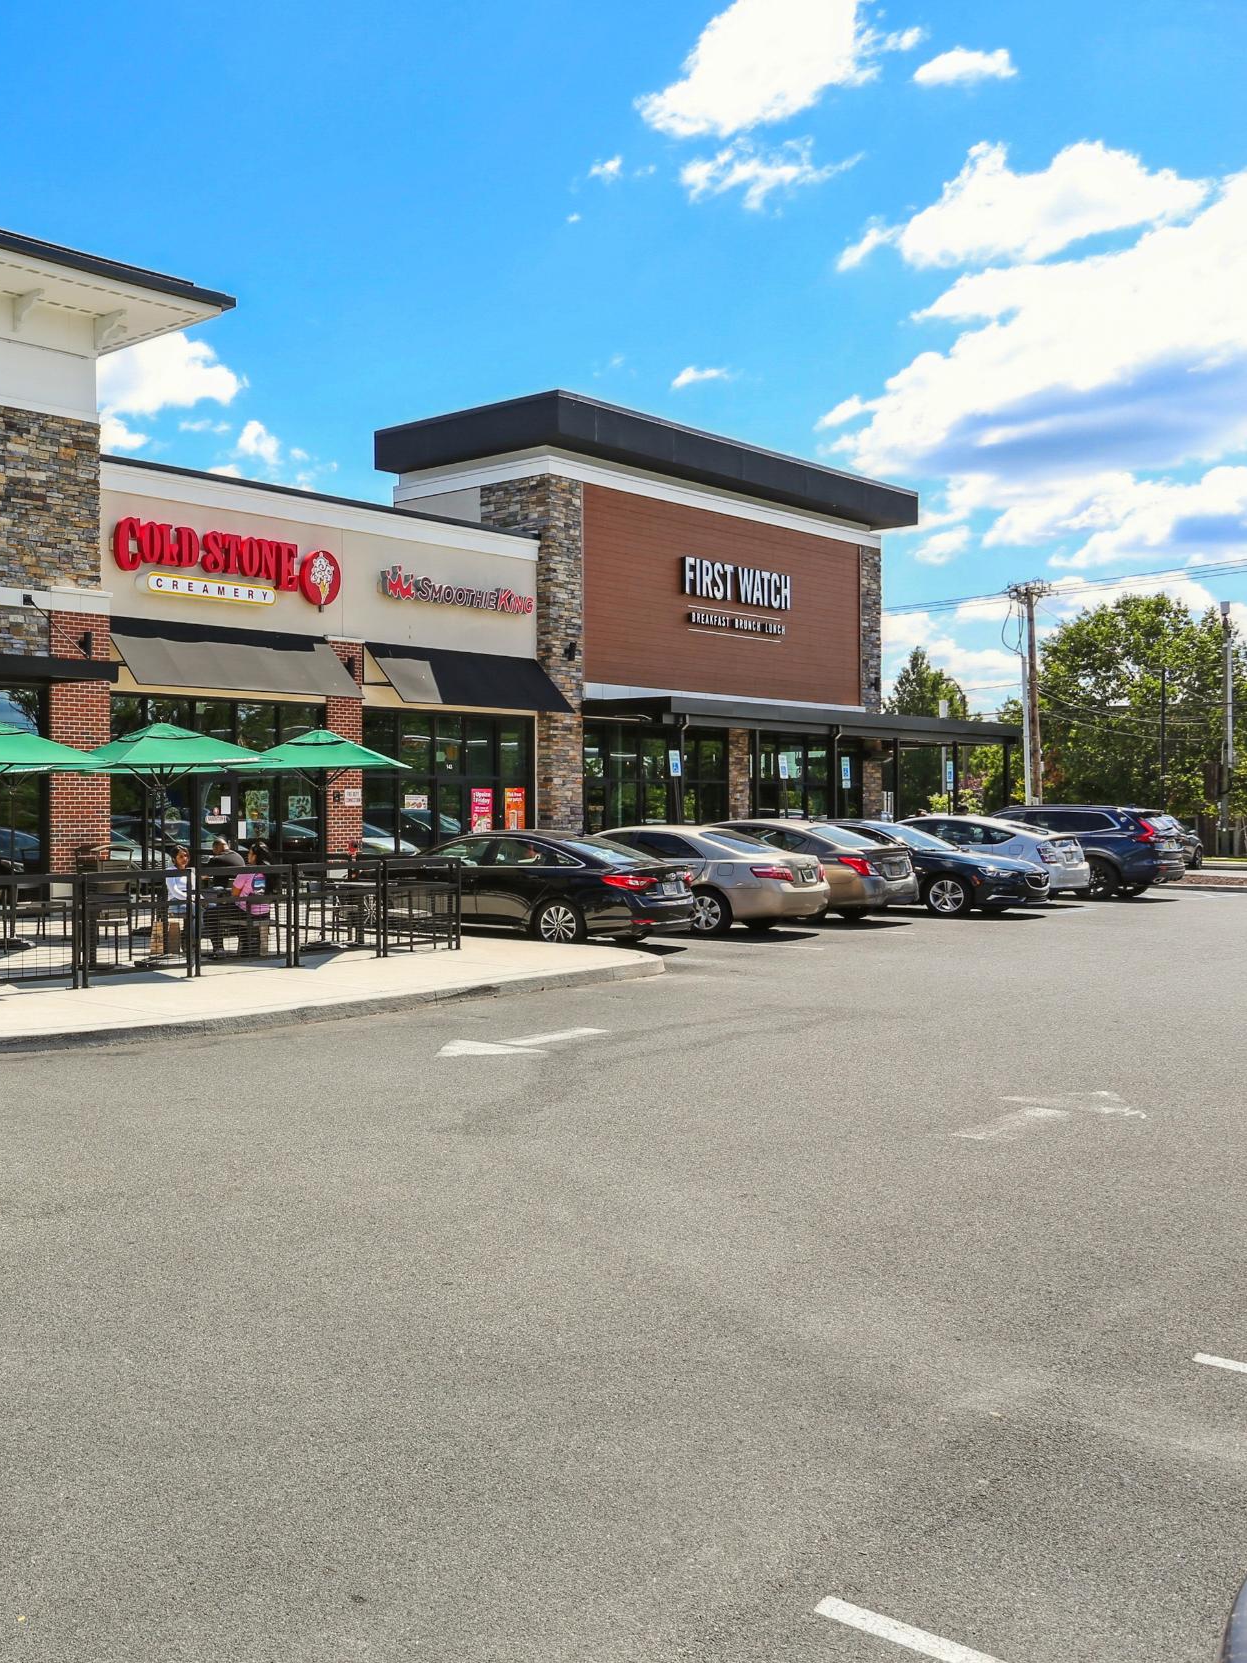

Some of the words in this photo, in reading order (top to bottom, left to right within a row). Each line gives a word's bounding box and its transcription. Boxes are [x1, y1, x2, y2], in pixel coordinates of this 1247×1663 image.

[114, 516, 200, 571] COLD
[201, 530, 298, 592] STONE
[156, 578, 268, 601] CREAMERY
[418, 576, 497, 610] SMOOTHIE
[684, 556, 735, 601] FIRST
[737, 566, 791, 610] WATCH
[691, 612, 730, 627] BREAKFAST
[734, 618, 761, 632] BRUNCH
[765, 622, 786, 635] LUNCH
